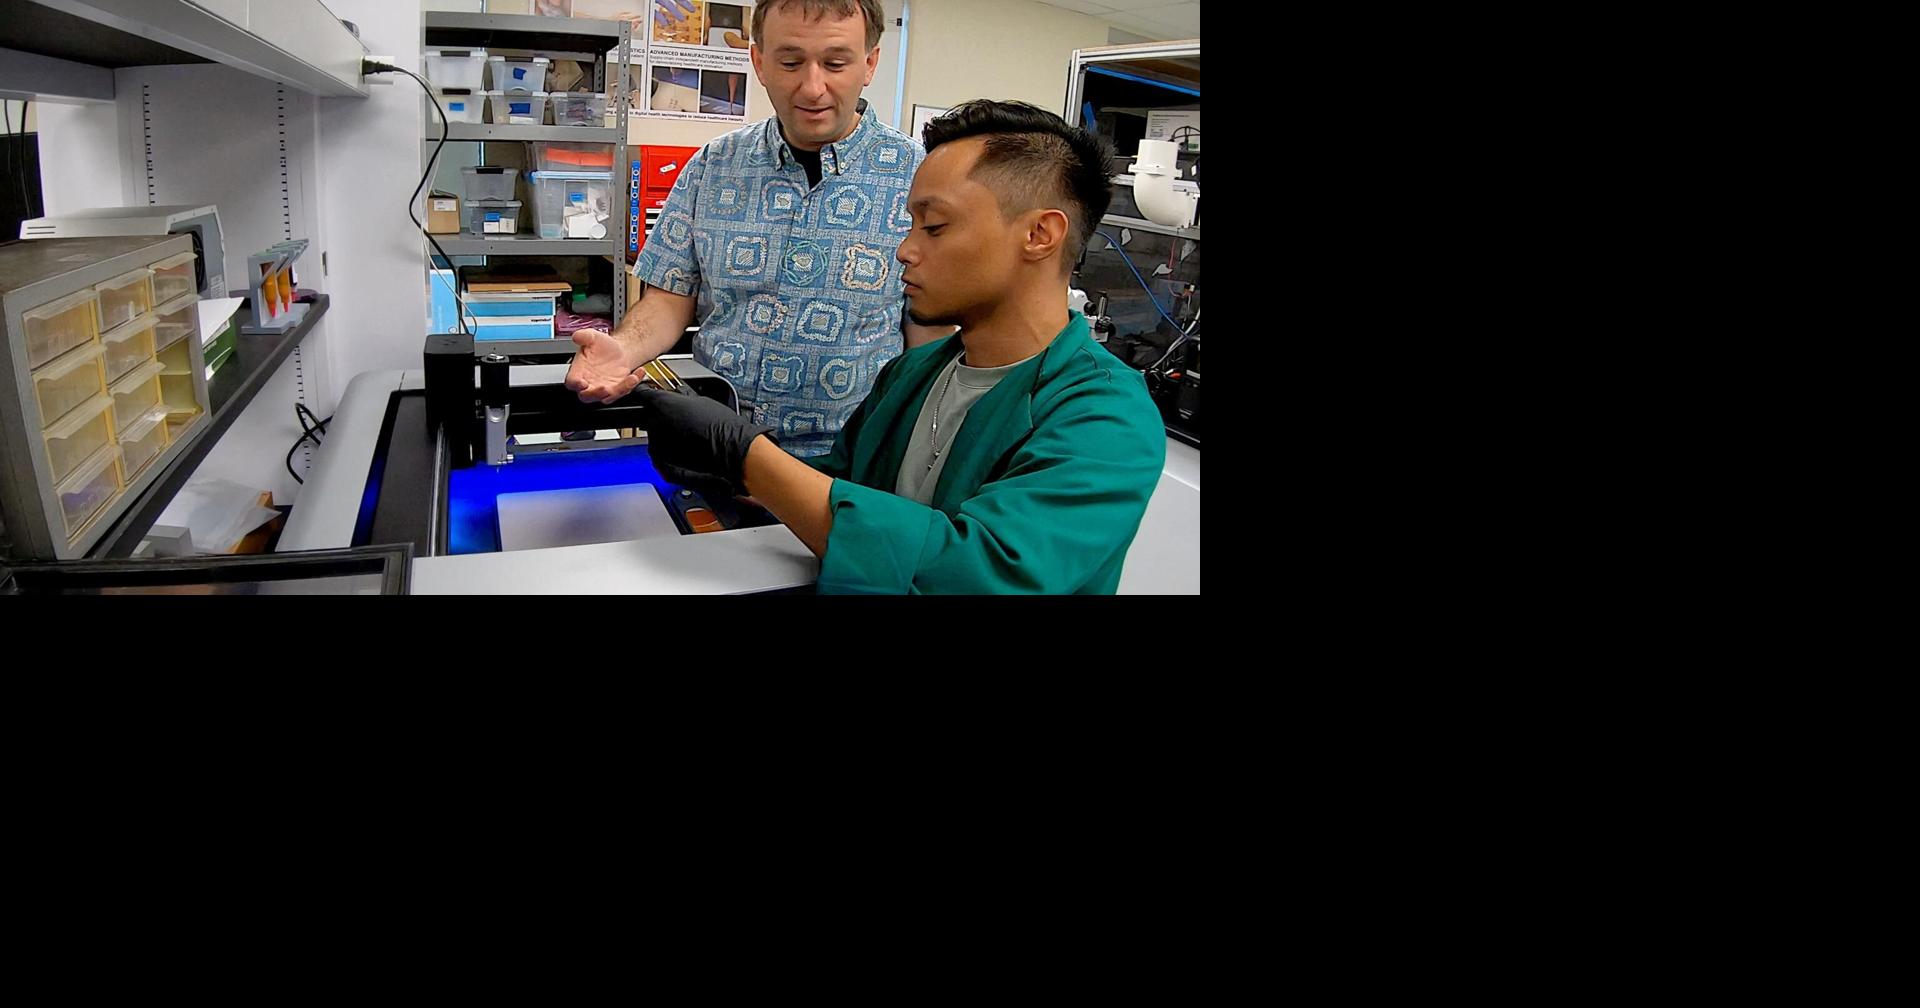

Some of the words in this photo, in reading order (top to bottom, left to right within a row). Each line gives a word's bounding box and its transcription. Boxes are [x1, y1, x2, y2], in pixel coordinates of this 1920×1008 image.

[650, 49, 679, 57] ADVANCED
[680, 51, 724, 60] MANUFACTURING
[724, 55, 750, 63] METHODS
